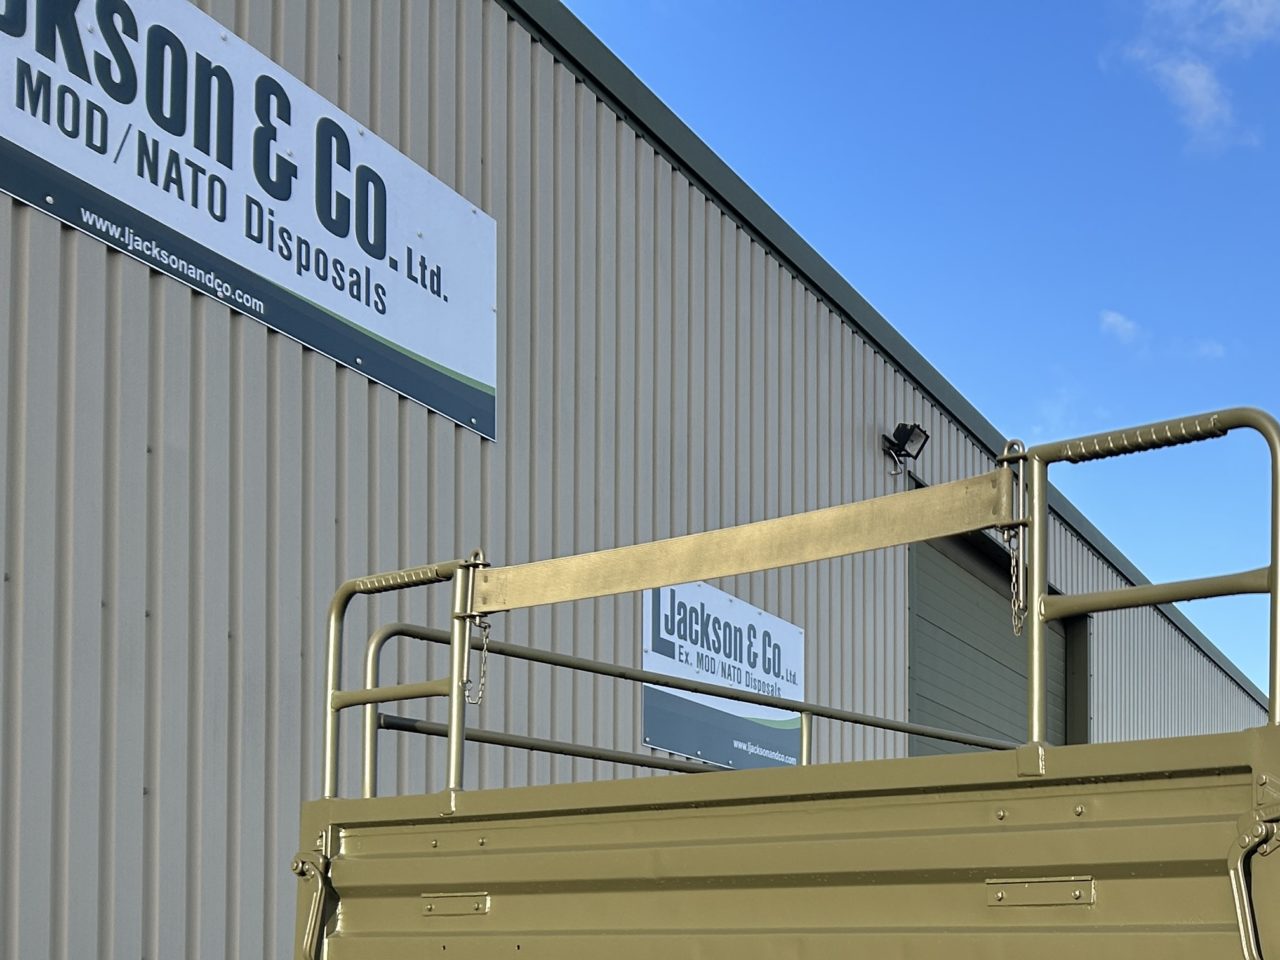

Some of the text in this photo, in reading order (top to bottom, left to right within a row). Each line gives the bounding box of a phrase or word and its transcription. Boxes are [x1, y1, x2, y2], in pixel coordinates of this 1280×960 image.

[0, 0, 448, 302] kson & Co. Ltd.
[16, 57, 387, 315] MOD/NATO Disposals
[80, 207, 265, 315] www.ljacksonandco.com
[664, 588, 742, 664] Jackson
[747, 623, 758, 669] &
[762, 630, 784, 680] Co.
[678, 644, 782, 698] Ex. MOD/NATO Disposals
